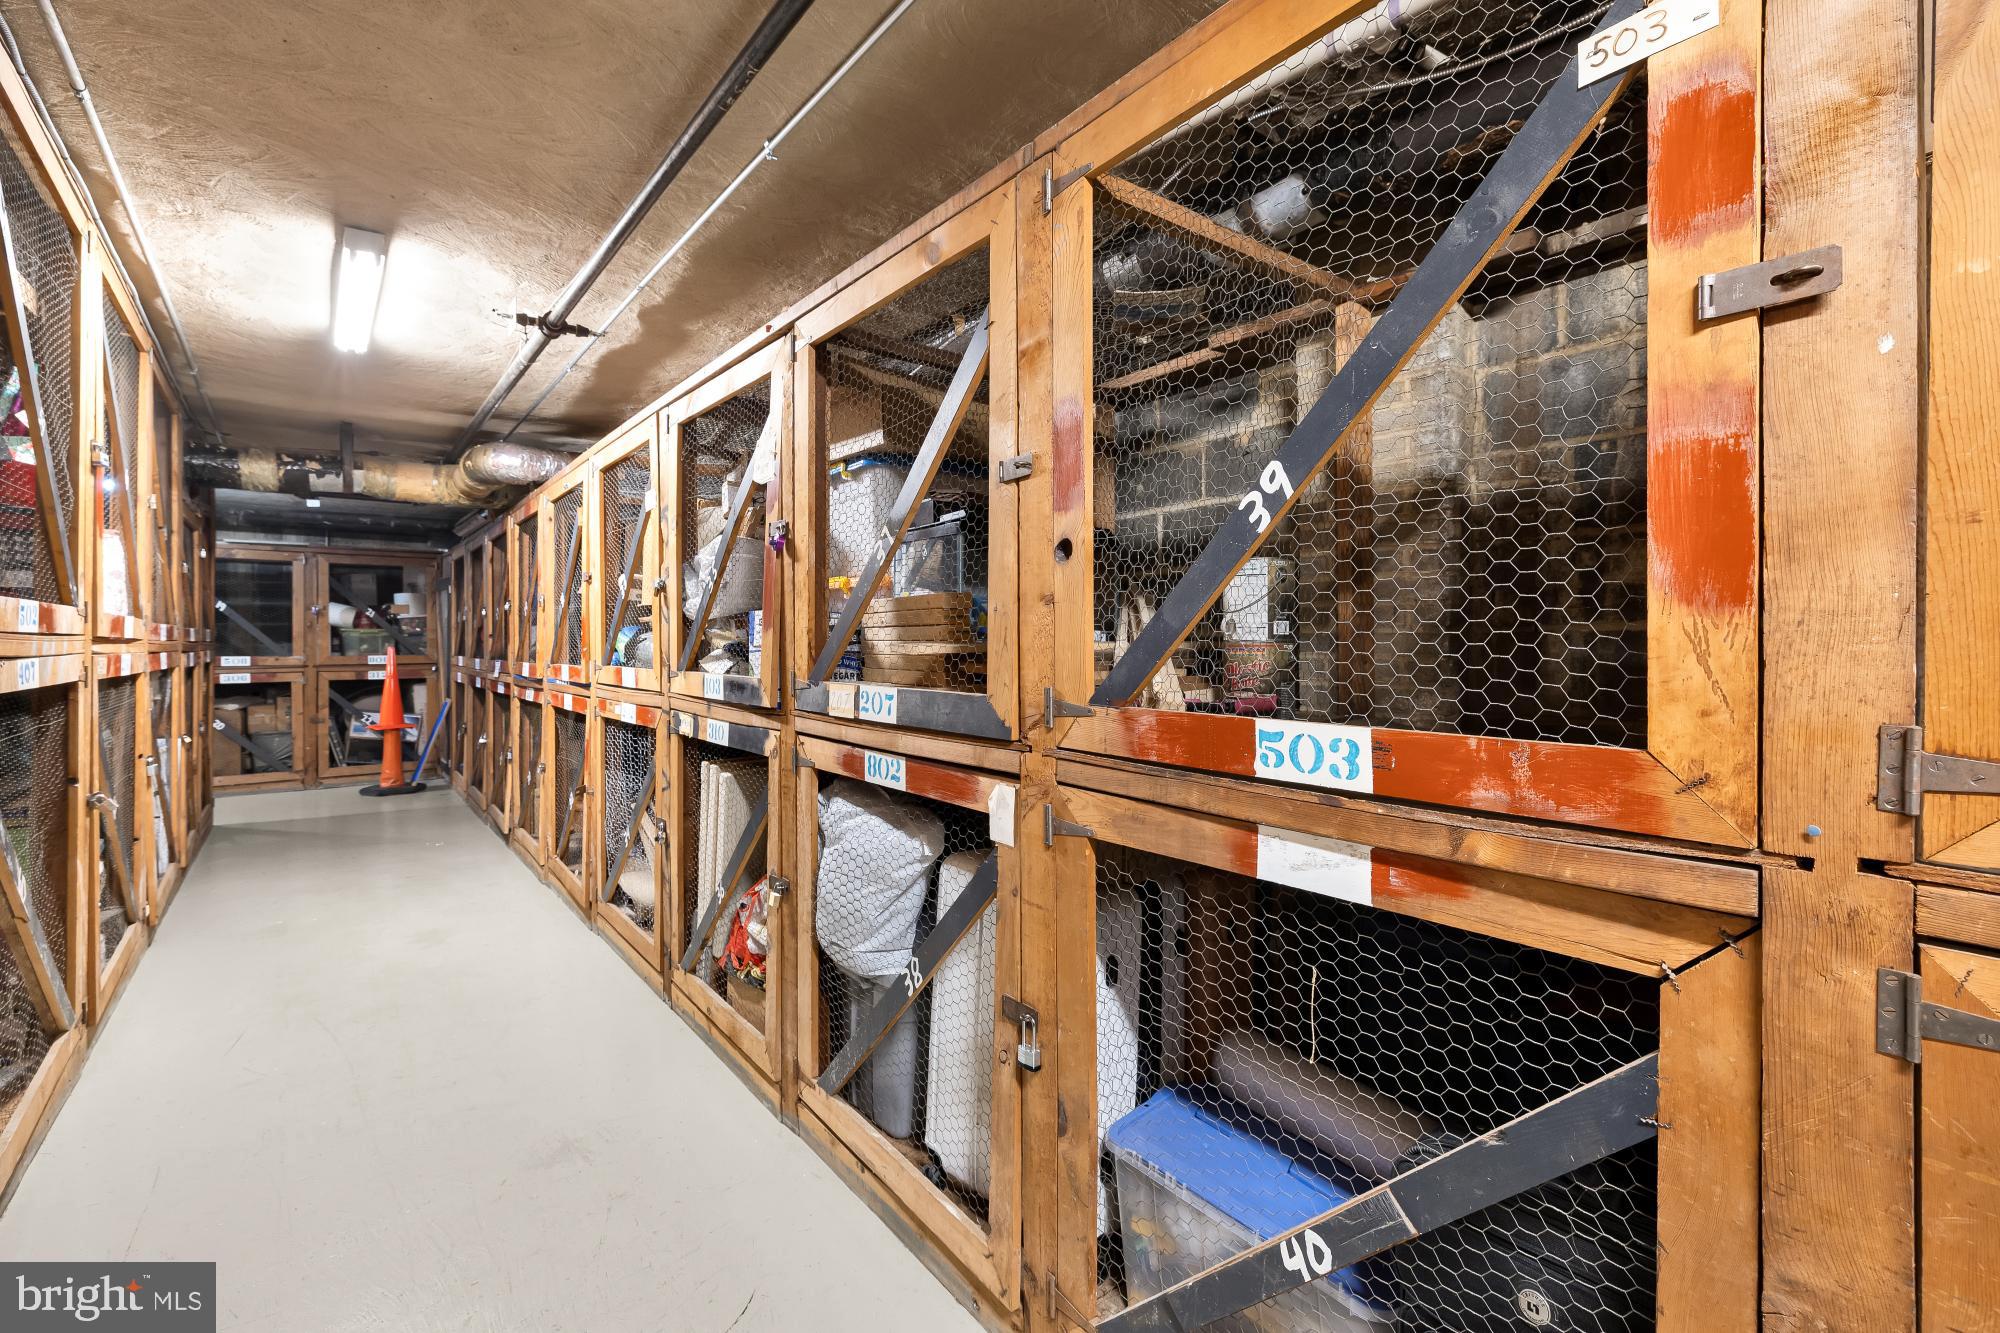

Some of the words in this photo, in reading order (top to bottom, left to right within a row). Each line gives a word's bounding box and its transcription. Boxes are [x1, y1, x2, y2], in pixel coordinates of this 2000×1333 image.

[1590, 8, 1669, 68] 503
[1238, 460, 1294, 533] 39
[20, 605, 38, 625] 502
[19, 660, 36, 685] 407
[704, 677, 721, 695] 103
[860, 690, 895, 717] 207
[708, 721, 725, 741] 310
[867, 754, 901, 783] 802
[1257, 728, 1361, 781] 503
[901, 956, 923, 997] 38
[1280, 1229, 1333, 1283] 40
